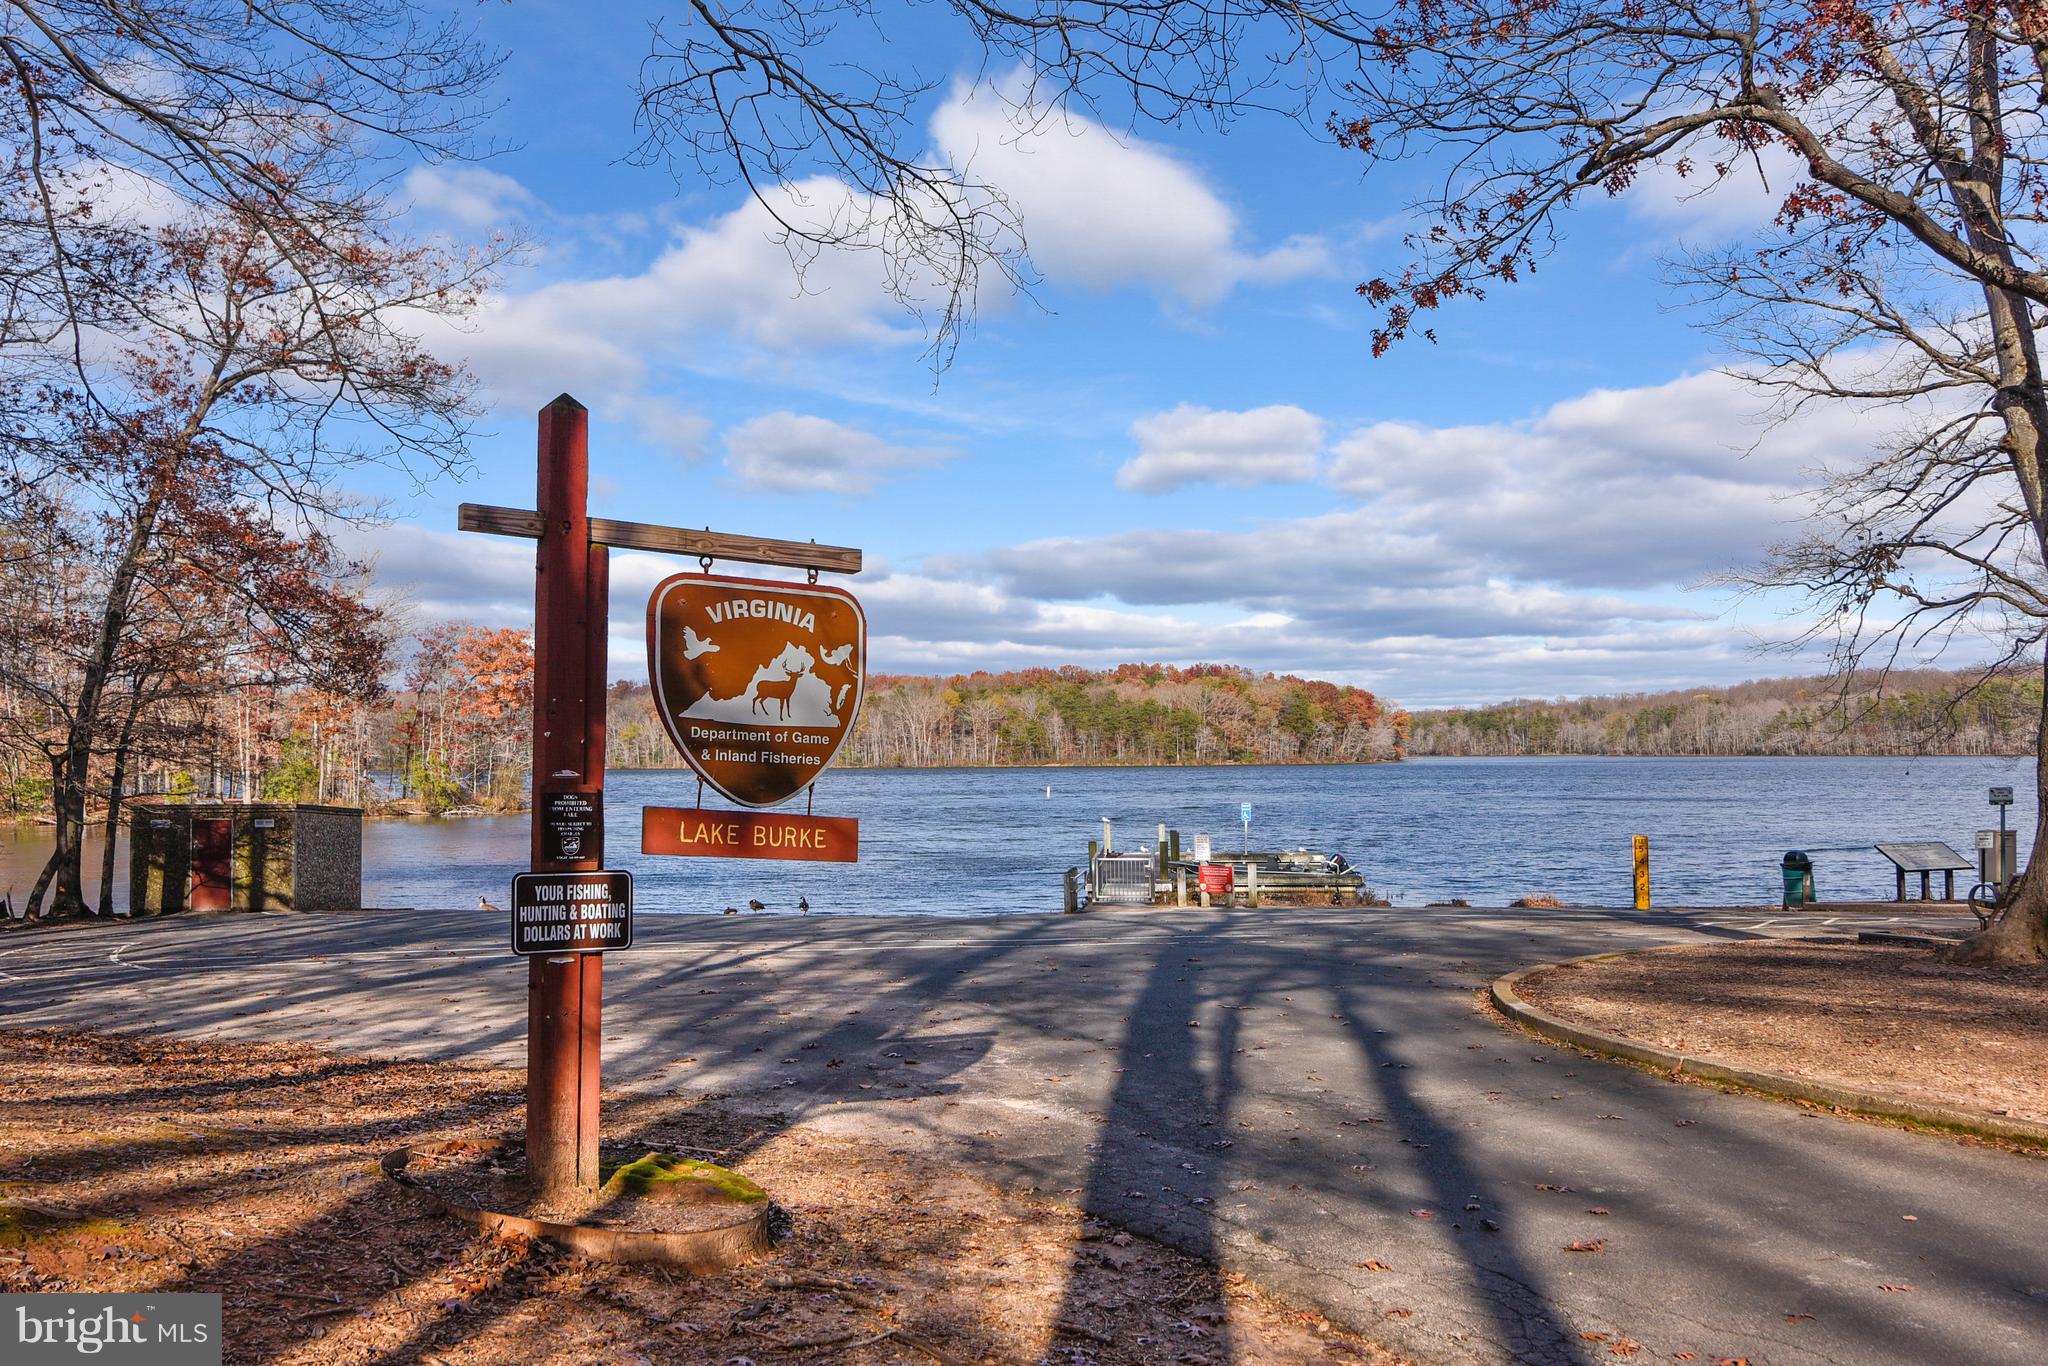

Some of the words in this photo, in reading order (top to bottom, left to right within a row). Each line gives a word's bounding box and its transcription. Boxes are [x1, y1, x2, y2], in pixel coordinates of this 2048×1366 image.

[706, 600, 816, 632] VIRGINIA
[691, 726, 771, 742] Department
[775, 730, 789, 742] of
[792, 731, 830, 745] Game
[701, 749, 711, 760] &
[716, 749, 756, 762] Inland
[761, 751, 821, 765] Fisheries
[680, 821, 740, 845] LAKE
[754, 826, 826, 848] BURKE
[535, 886, 563, 901] YOUR
[567, 884, 611, 902] FISHING,
[520, 905, 566, 922] HUNTING
[570, 905, 577, 920] &
[581, 902, 626, 919] BOATING
[524, 925, 571, 942] DOLLARS
[573, 924, 586, 940] AT
[589, 922, 621, 939] WORK
